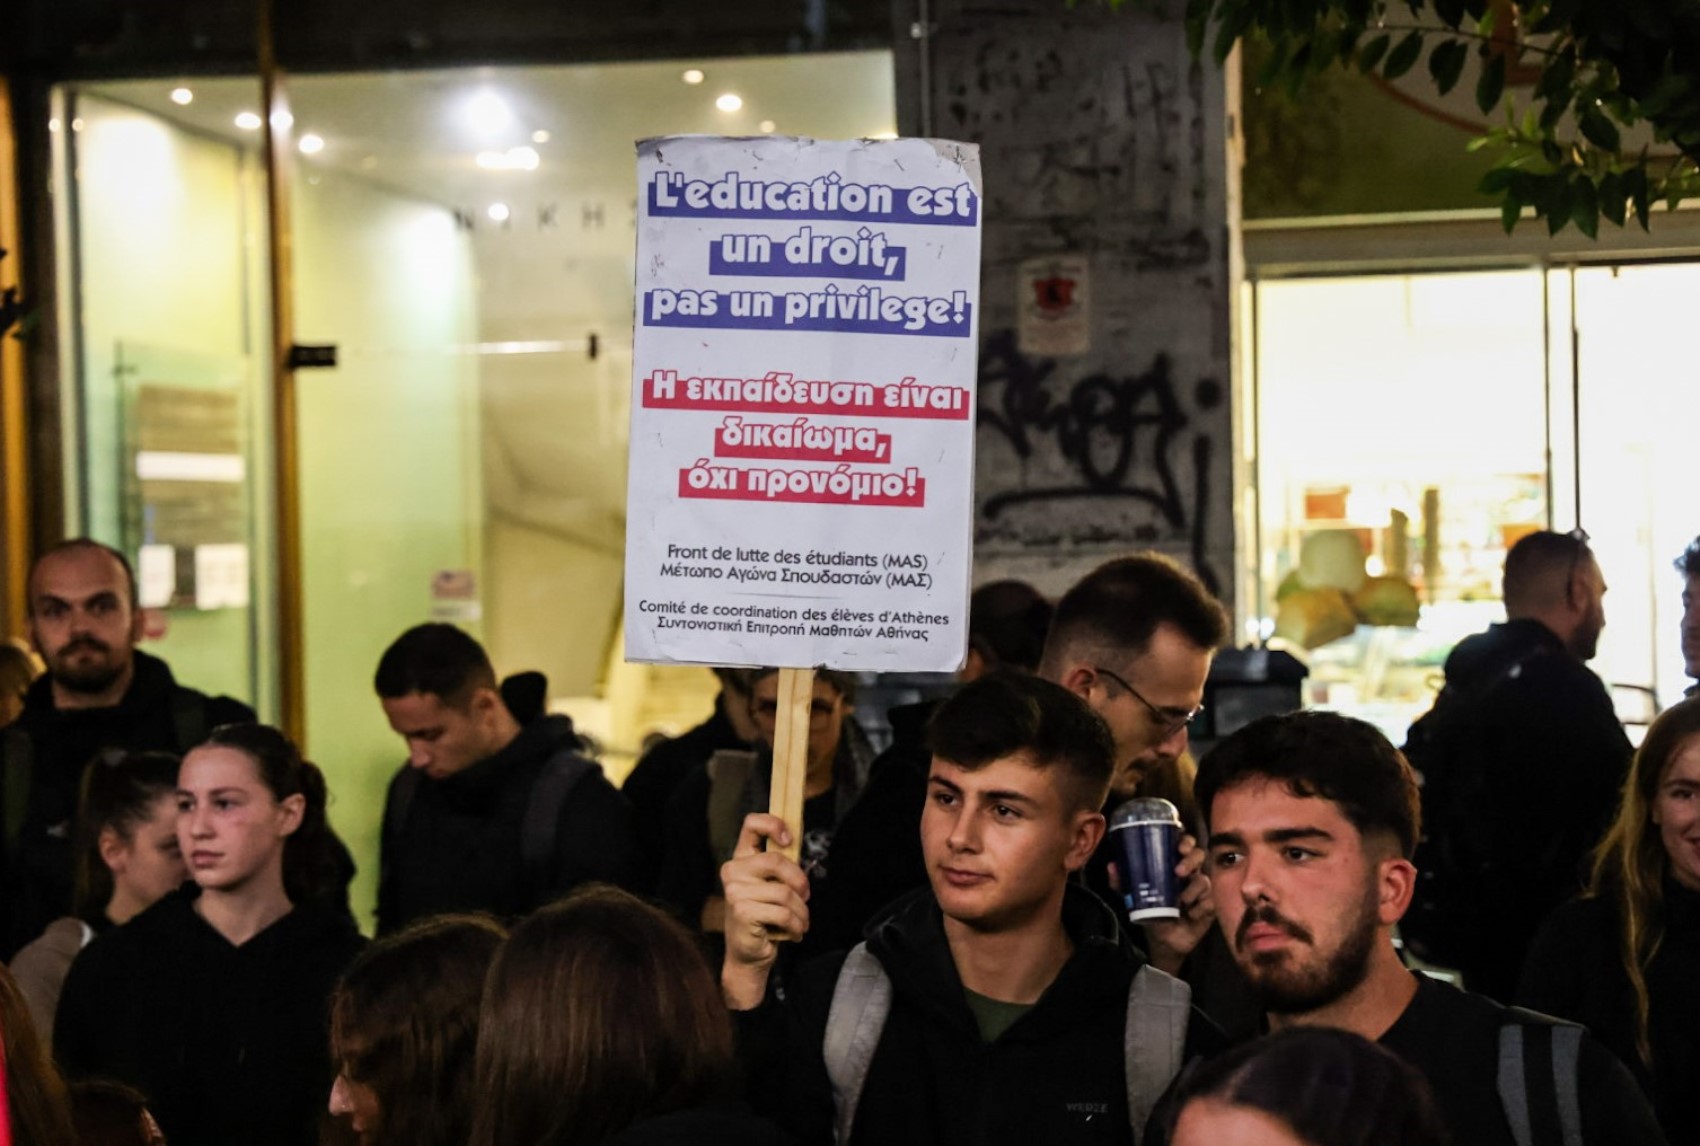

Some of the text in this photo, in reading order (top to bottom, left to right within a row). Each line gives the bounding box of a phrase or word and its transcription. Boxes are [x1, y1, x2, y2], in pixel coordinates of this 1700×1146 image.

[655, 171, 971, 217] L'education est
[721, 226, 899, 276] un droit,
[651, 284, 967, 330] pas un privilege!
[686, 371, 875, 406] εκπαίδευση
[883, 377, 963, 410] είναι
[722, 415, 886, 458] δικαίωμα,
[687, 458, 919, 500] όχι προνόμιο!
[660, 562, 933, 590] Μέτωπο Αγώνα Σπουδαστών (ΜΑΣ)
[668, 543, 928, 571] Front de lutte des étudiants (MAS)
[639, 599, 950, 625] Comité de coordination des élèves d'Athènes
[657, 616, 929, 642] Συντονιστική Επιτροπή Μαθητών Αθήνας
